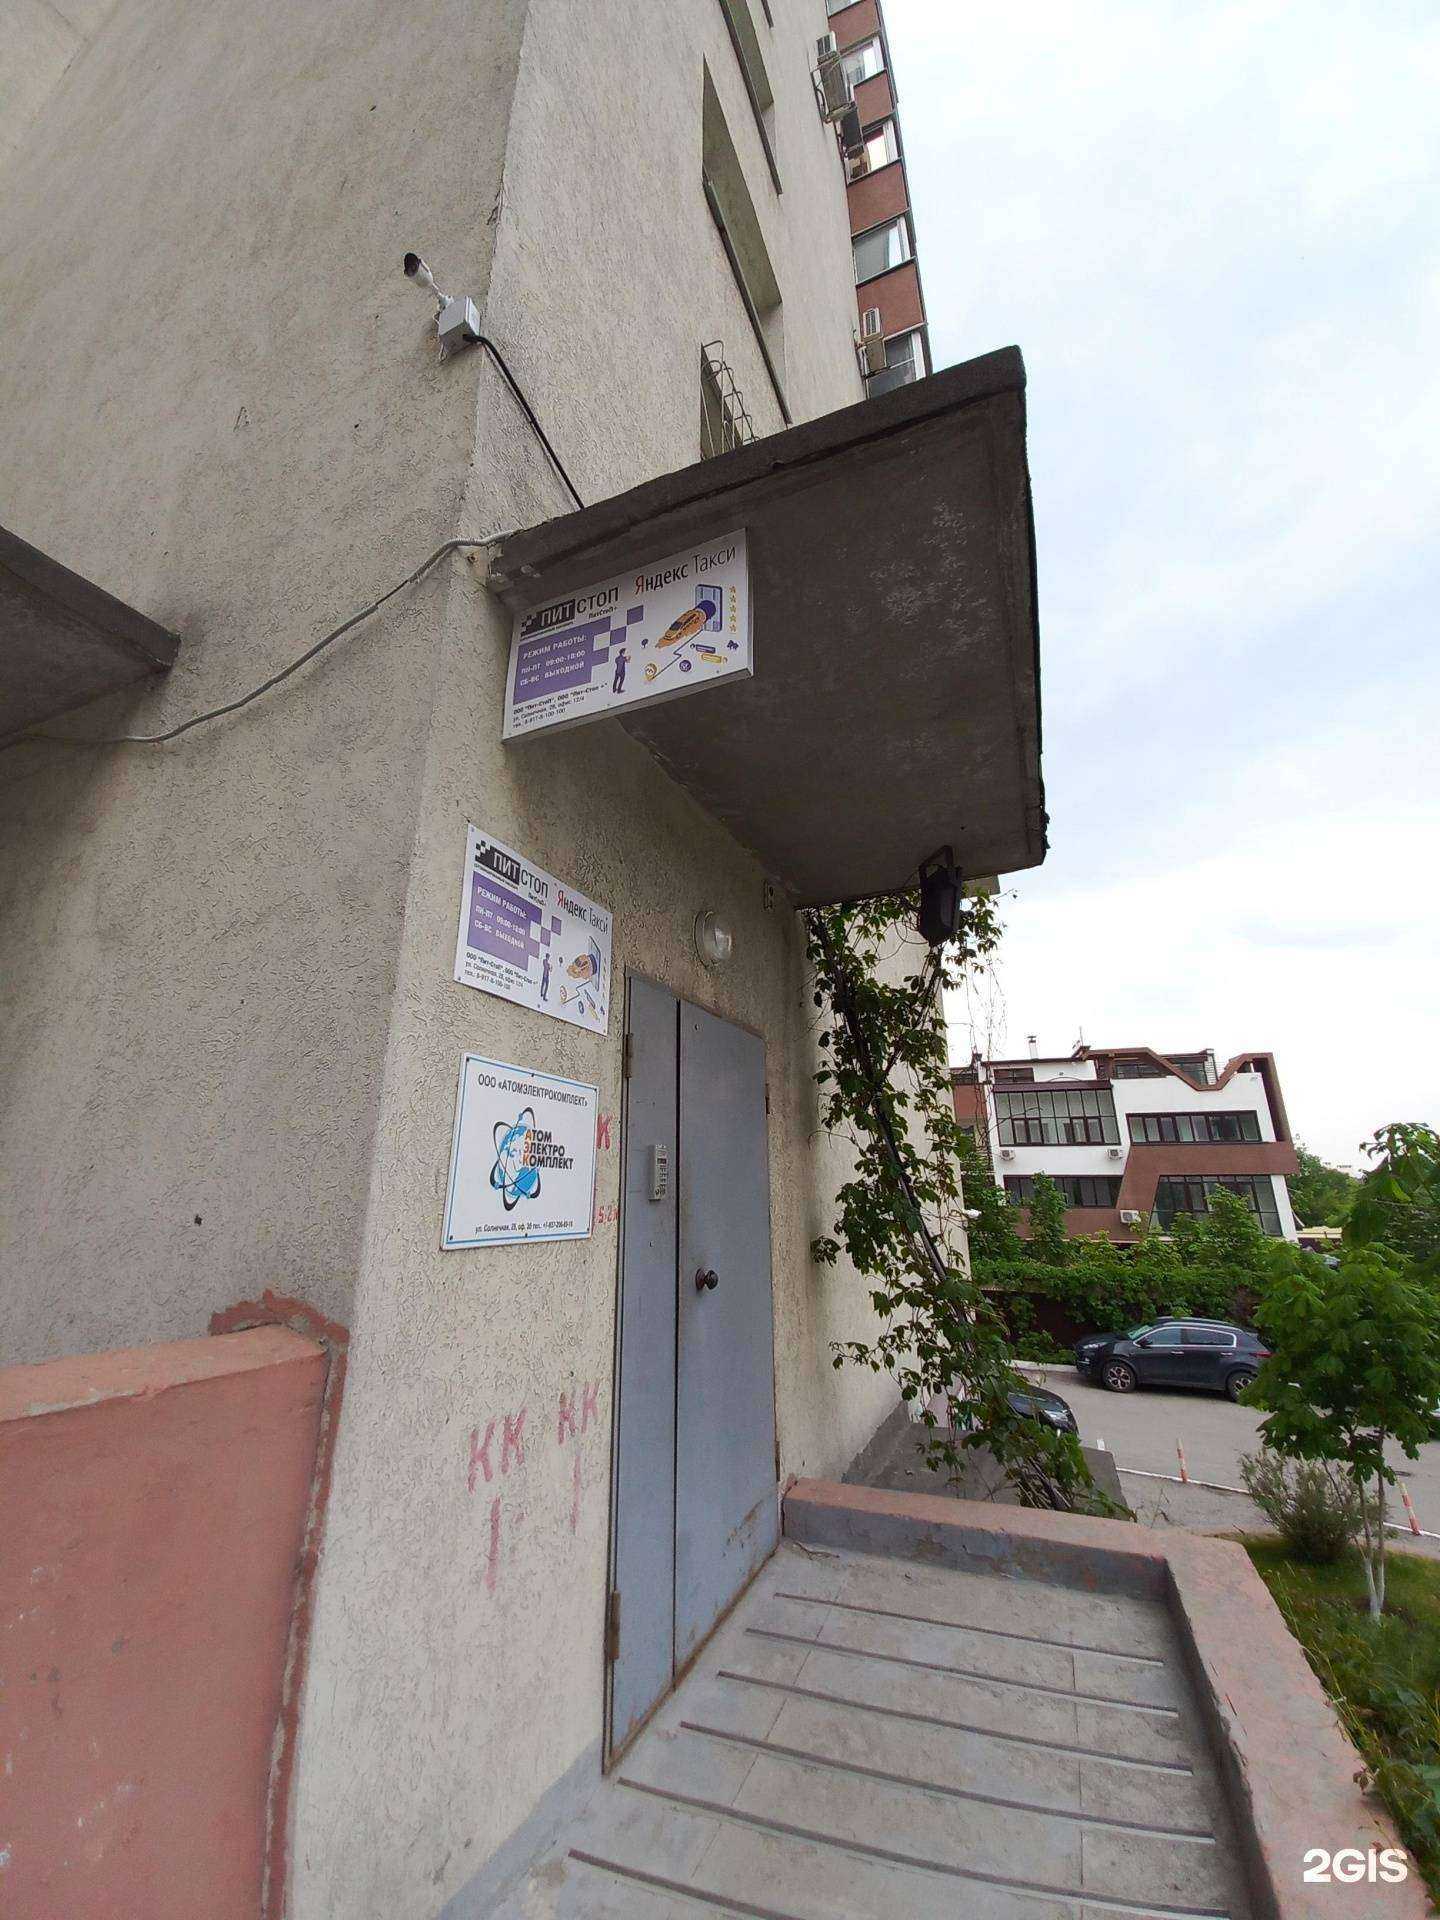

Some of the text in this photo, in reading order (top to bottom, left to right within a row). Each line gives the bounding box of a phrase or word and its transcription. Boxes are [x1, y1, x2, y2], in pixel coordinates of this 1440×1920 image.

[635, 563, 688, 595] Яндекс
[693, 546, 736, 573] Такси
[523, 635, 587, 659] РЕЖИМ РАБОТЫ:
[520, 661, 584, 686] СБ-ВС ВЫХОДНОЙ
[521, 663, 541, 674] ПН-ПТ
[513, 706, 524, 715] ООО
[477, 886, 527, 918] РЕЖИМ РАБОТЫ:
[475, 905, 493, 918] ПН-ПТ
[557, 889, 586, 921] Яндекс
[588, 908, 608, 934] Такси
[474, 919, 492, 933] СБ-ВС
[478, 1073, 588, 1108] ООО «АТОМЭЛЕКТРОКОМПЛЕКТ»
[525, 1128, 552, 1142] АТОМ
[523, 1141, 565, 1157] ЭЛЕКТРО
[522, 1154, 574, 1170] КОМПЛЕКТ
